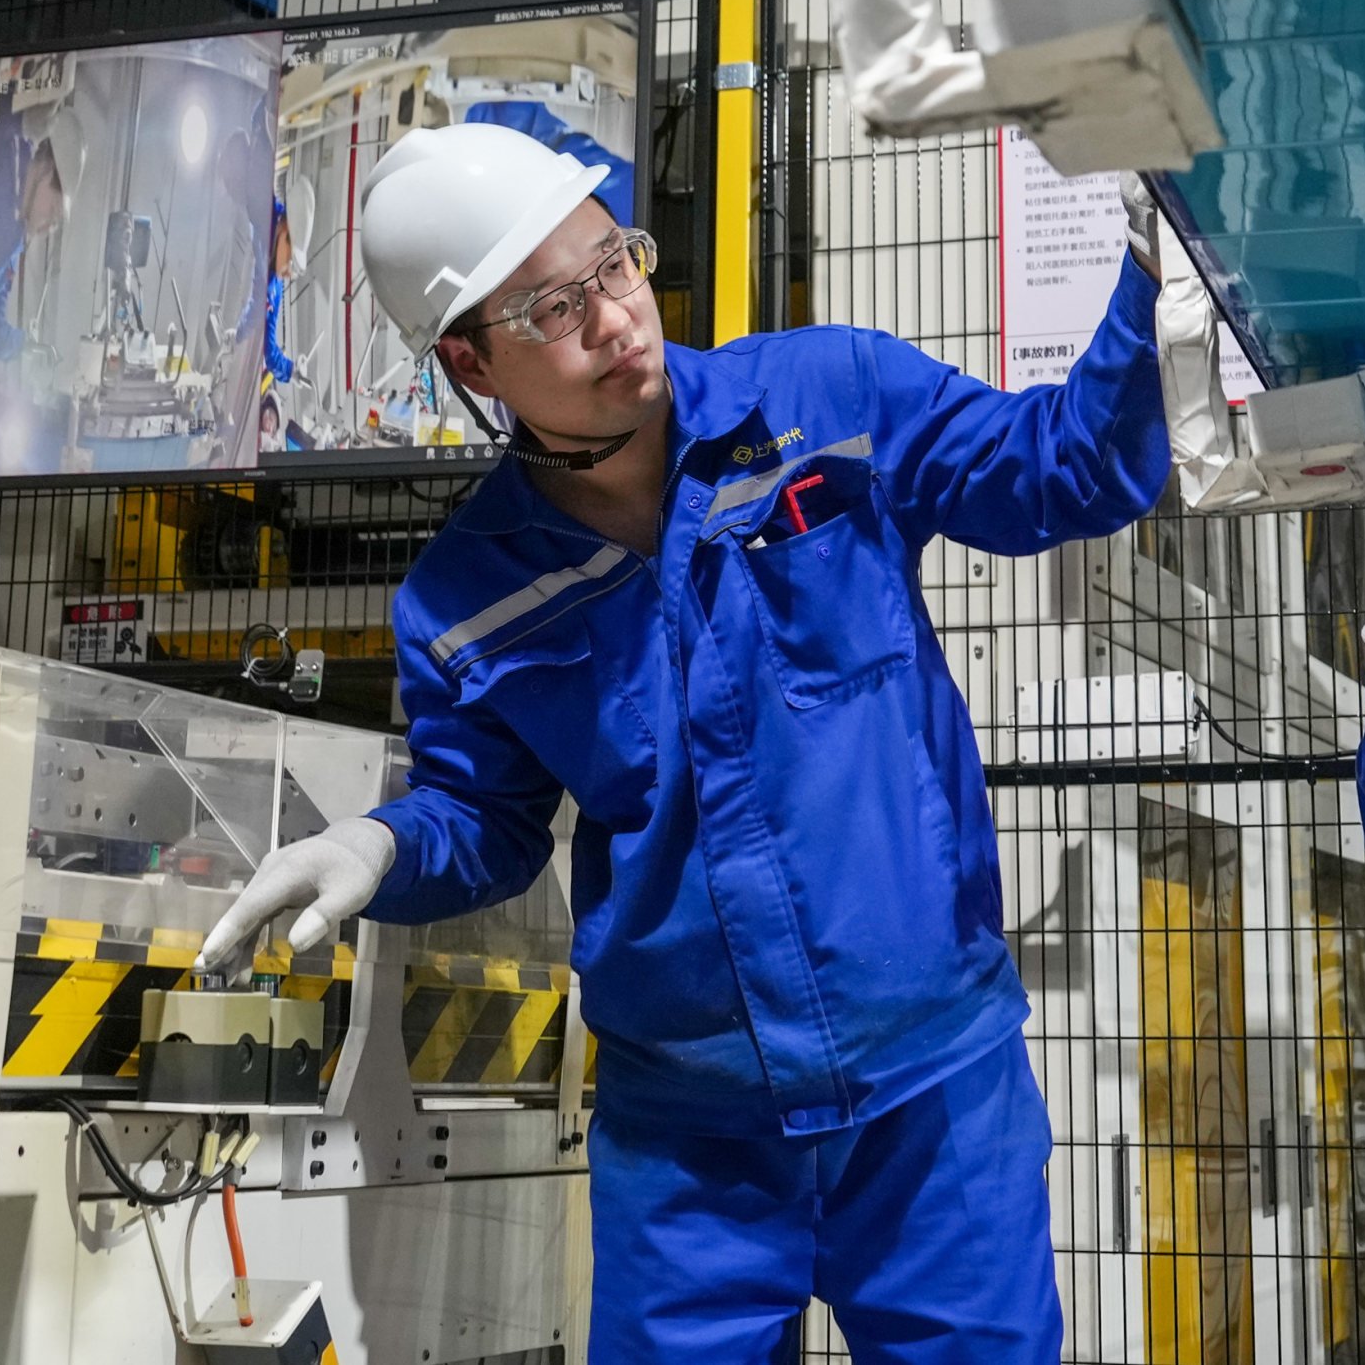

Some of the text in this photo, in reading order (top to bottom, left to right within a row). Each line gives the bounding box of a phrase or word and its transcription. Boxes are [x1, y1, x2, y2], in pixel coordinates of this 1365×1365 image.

[284, 33, 309, 42] Camera
[1013, 344, 1075, 361] 【事故教育】
[754, 427, 804, 459] 上汽时代
